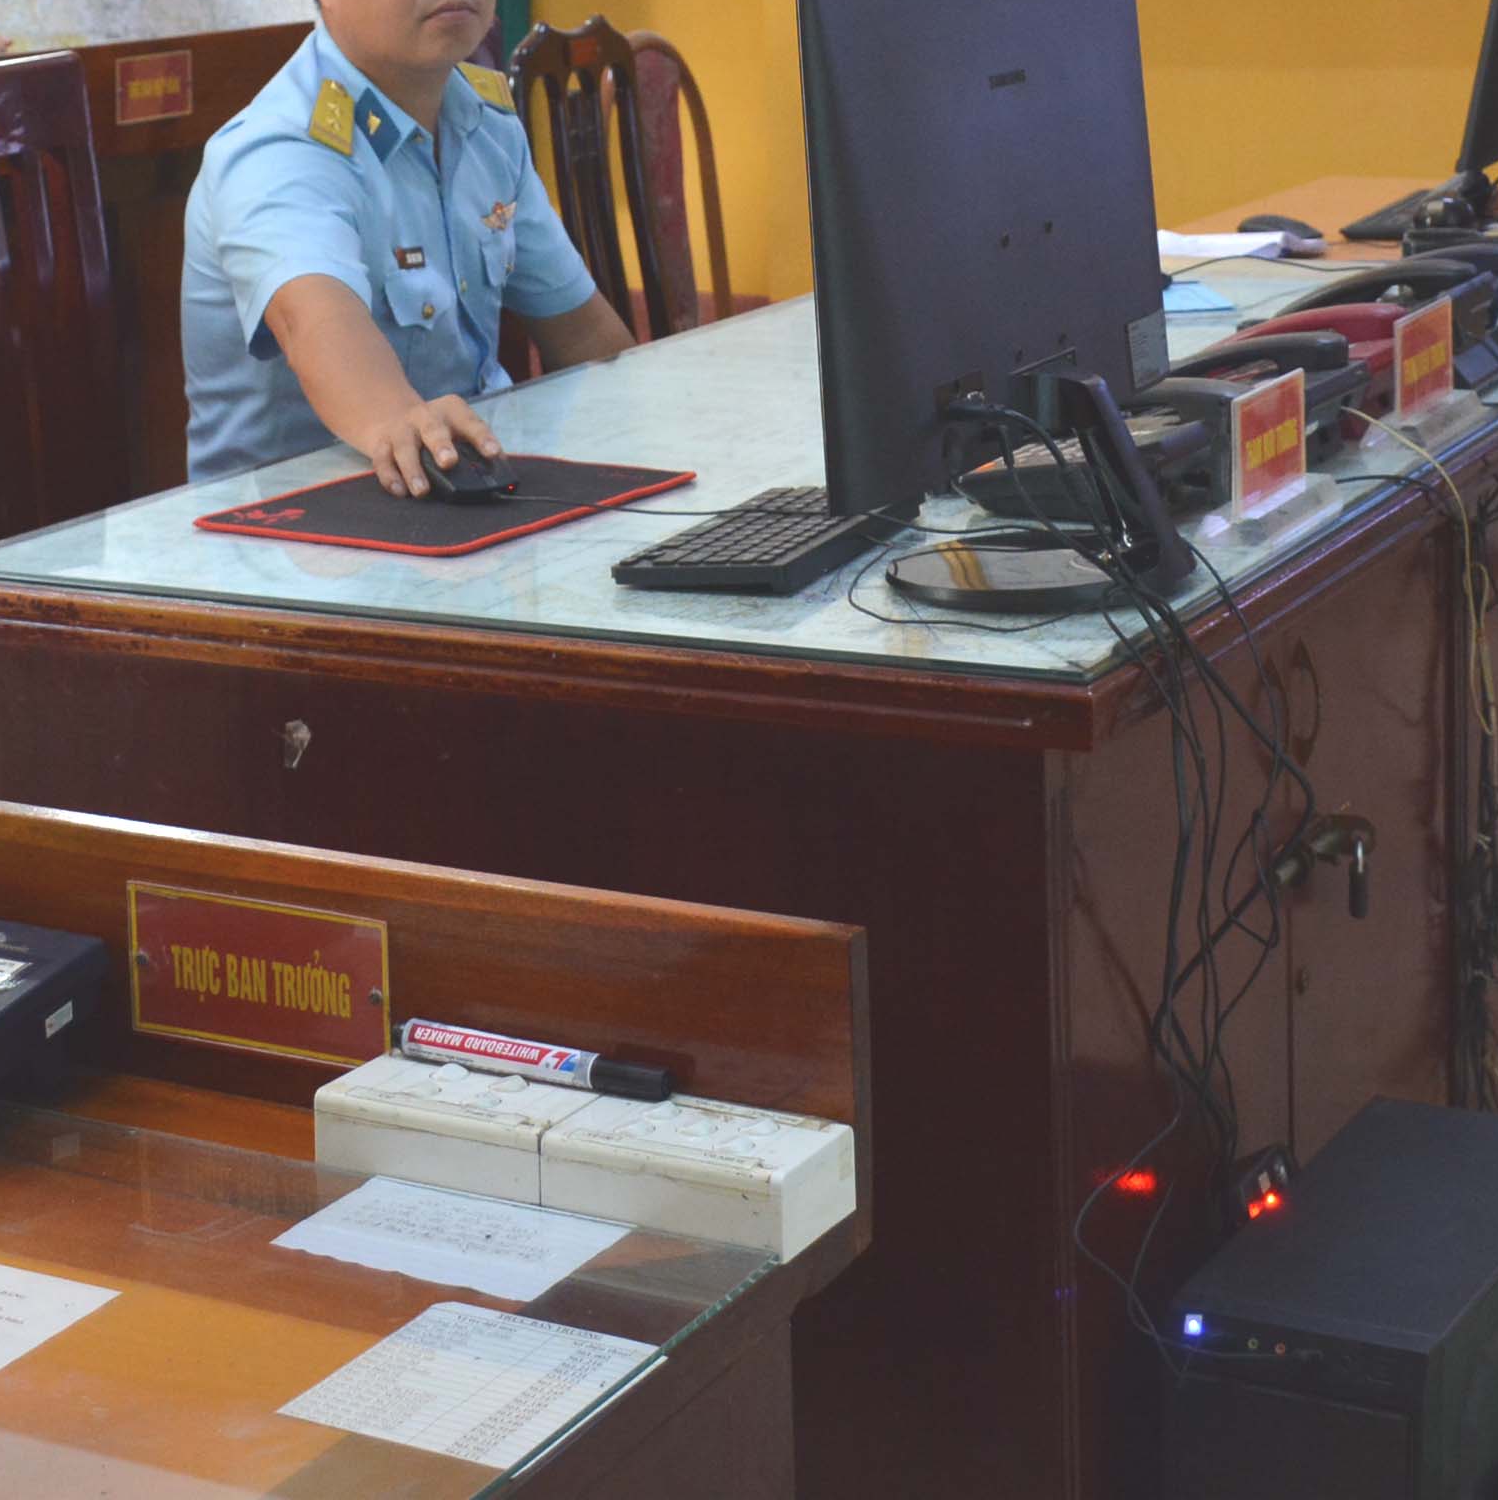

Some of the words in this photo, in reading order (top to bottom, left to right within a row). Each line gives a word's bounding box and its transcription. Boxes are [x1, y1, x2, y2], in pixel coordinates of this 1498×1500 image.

[170, 943, 222, 1004] TRỰC
[226, 953, 268, 1004] BAN
[271, 949, 352, 1020] TRƯỞNG
[413, 1025, 462, 1050] MARKER
[465, 1036, 541, 1061] WHITEBOARD
